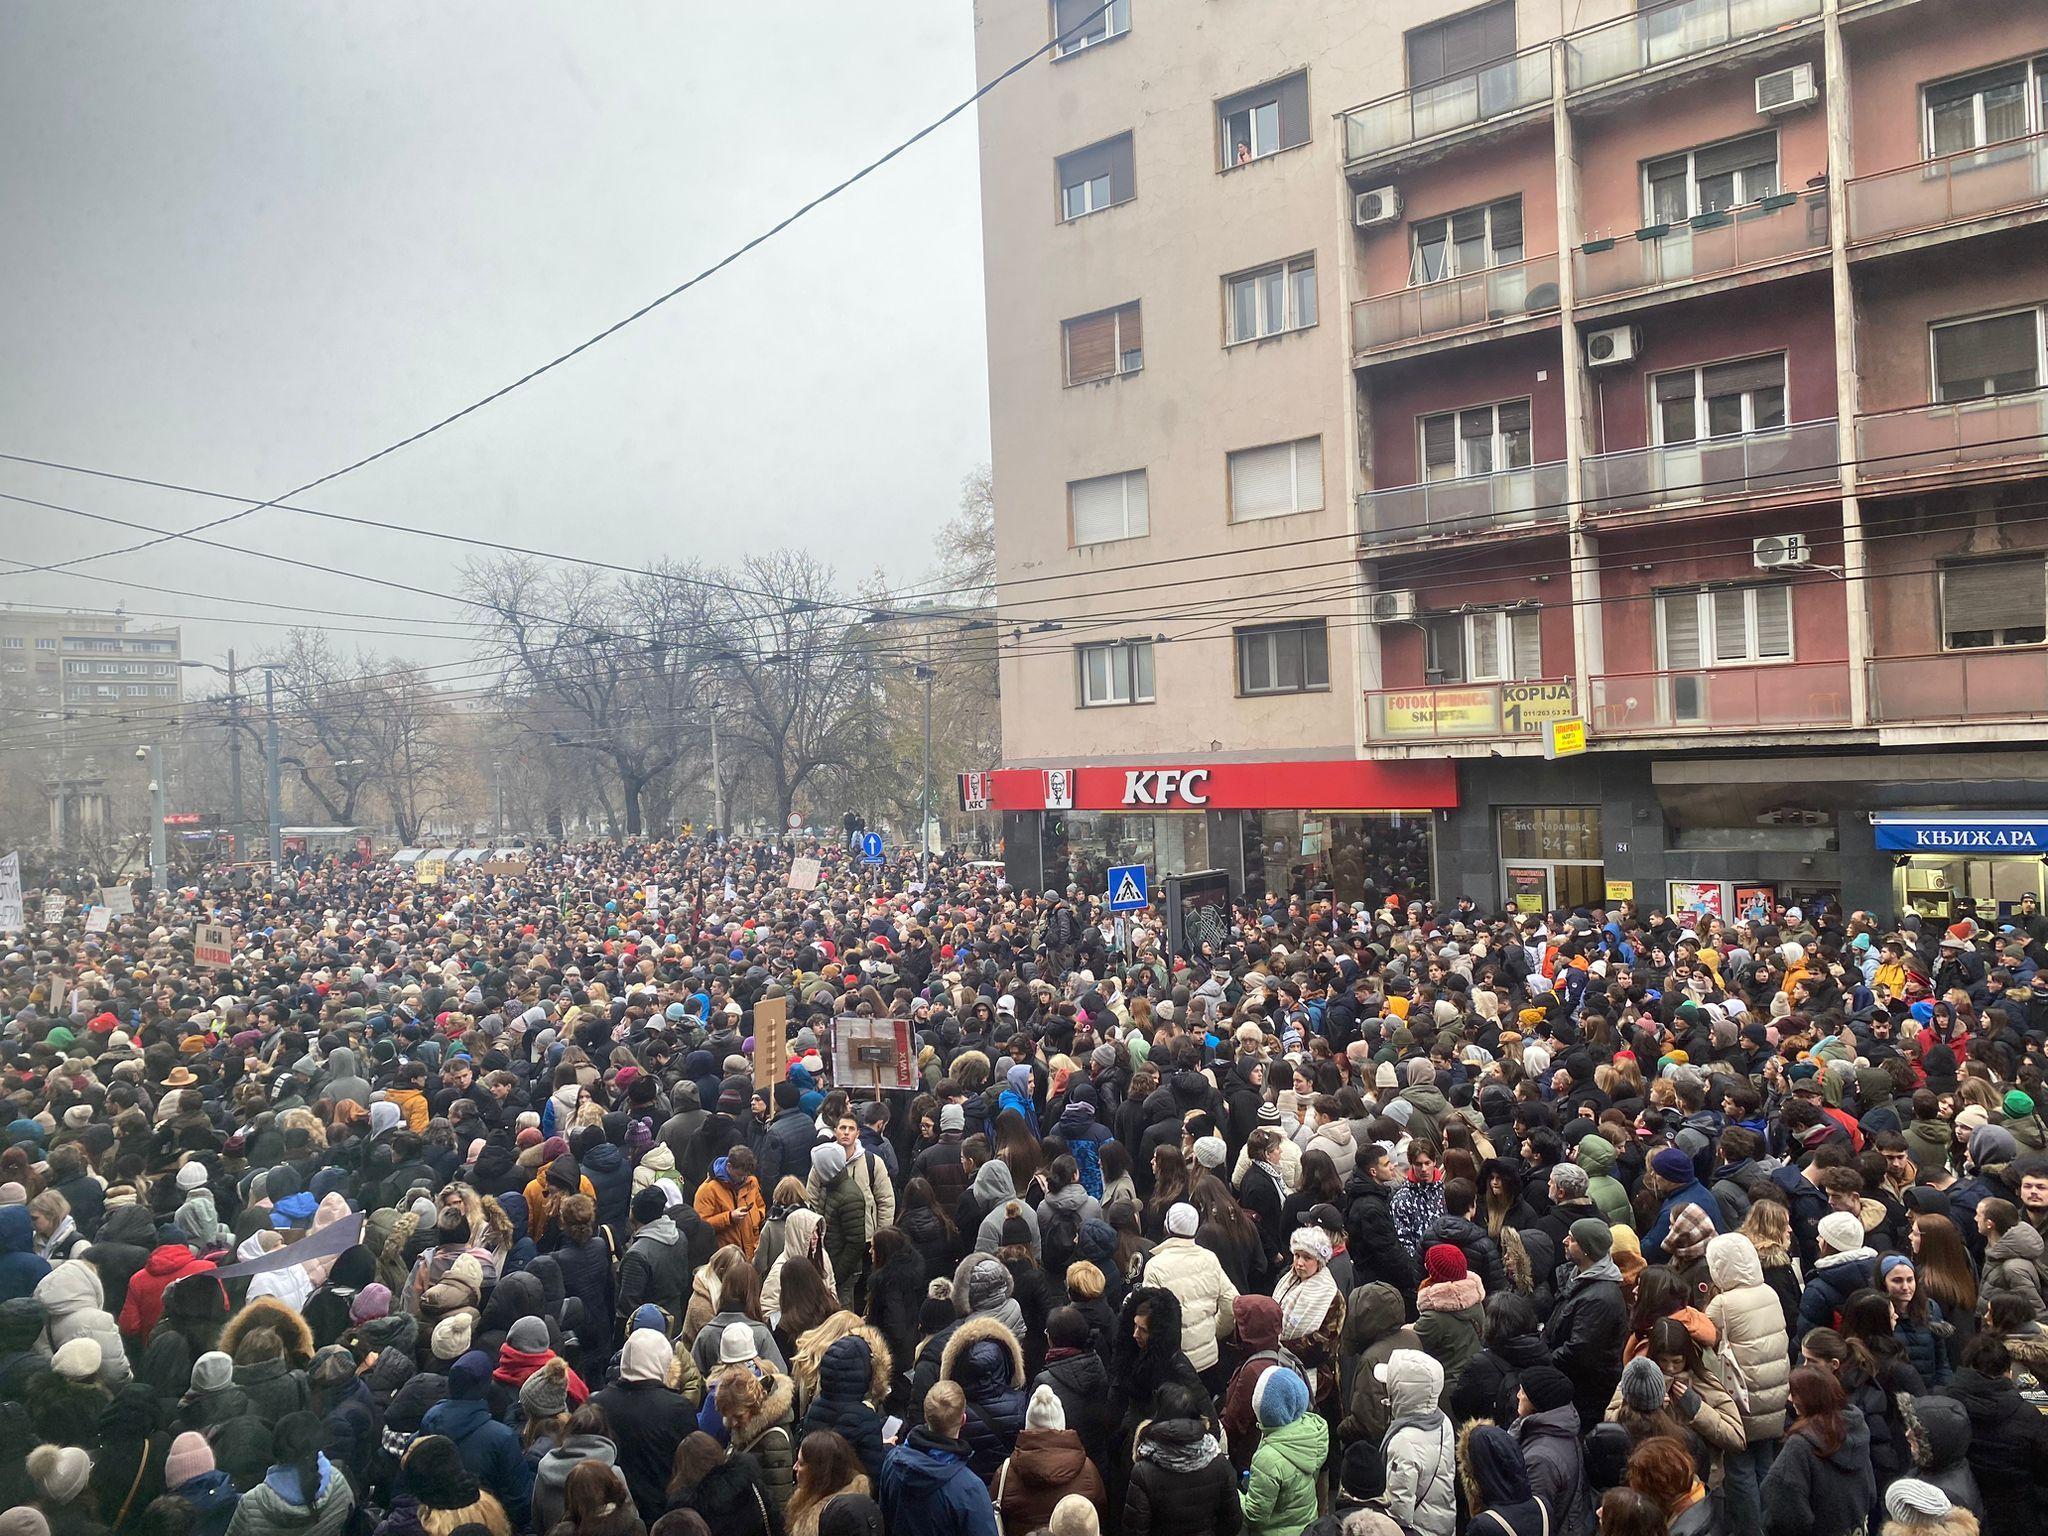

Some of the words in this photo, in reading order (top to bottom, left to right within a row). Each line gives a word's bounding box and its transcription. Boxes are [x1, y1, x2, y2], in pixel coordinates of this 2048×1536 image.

[1502, 685, 1571, 702] KOPIJA
[1504, 704, 1522, 732] 1
[1121, 769, 1208, 804] KFC
[969, 800, 984, 809] KFC
[1543, 836, 1561, 850] 24
[1916, 830, 2037, 846] КЊИЖАРА
[1617, 844, 1627, 852] 24
[899, 1051, 909, 1081] VIVAX
